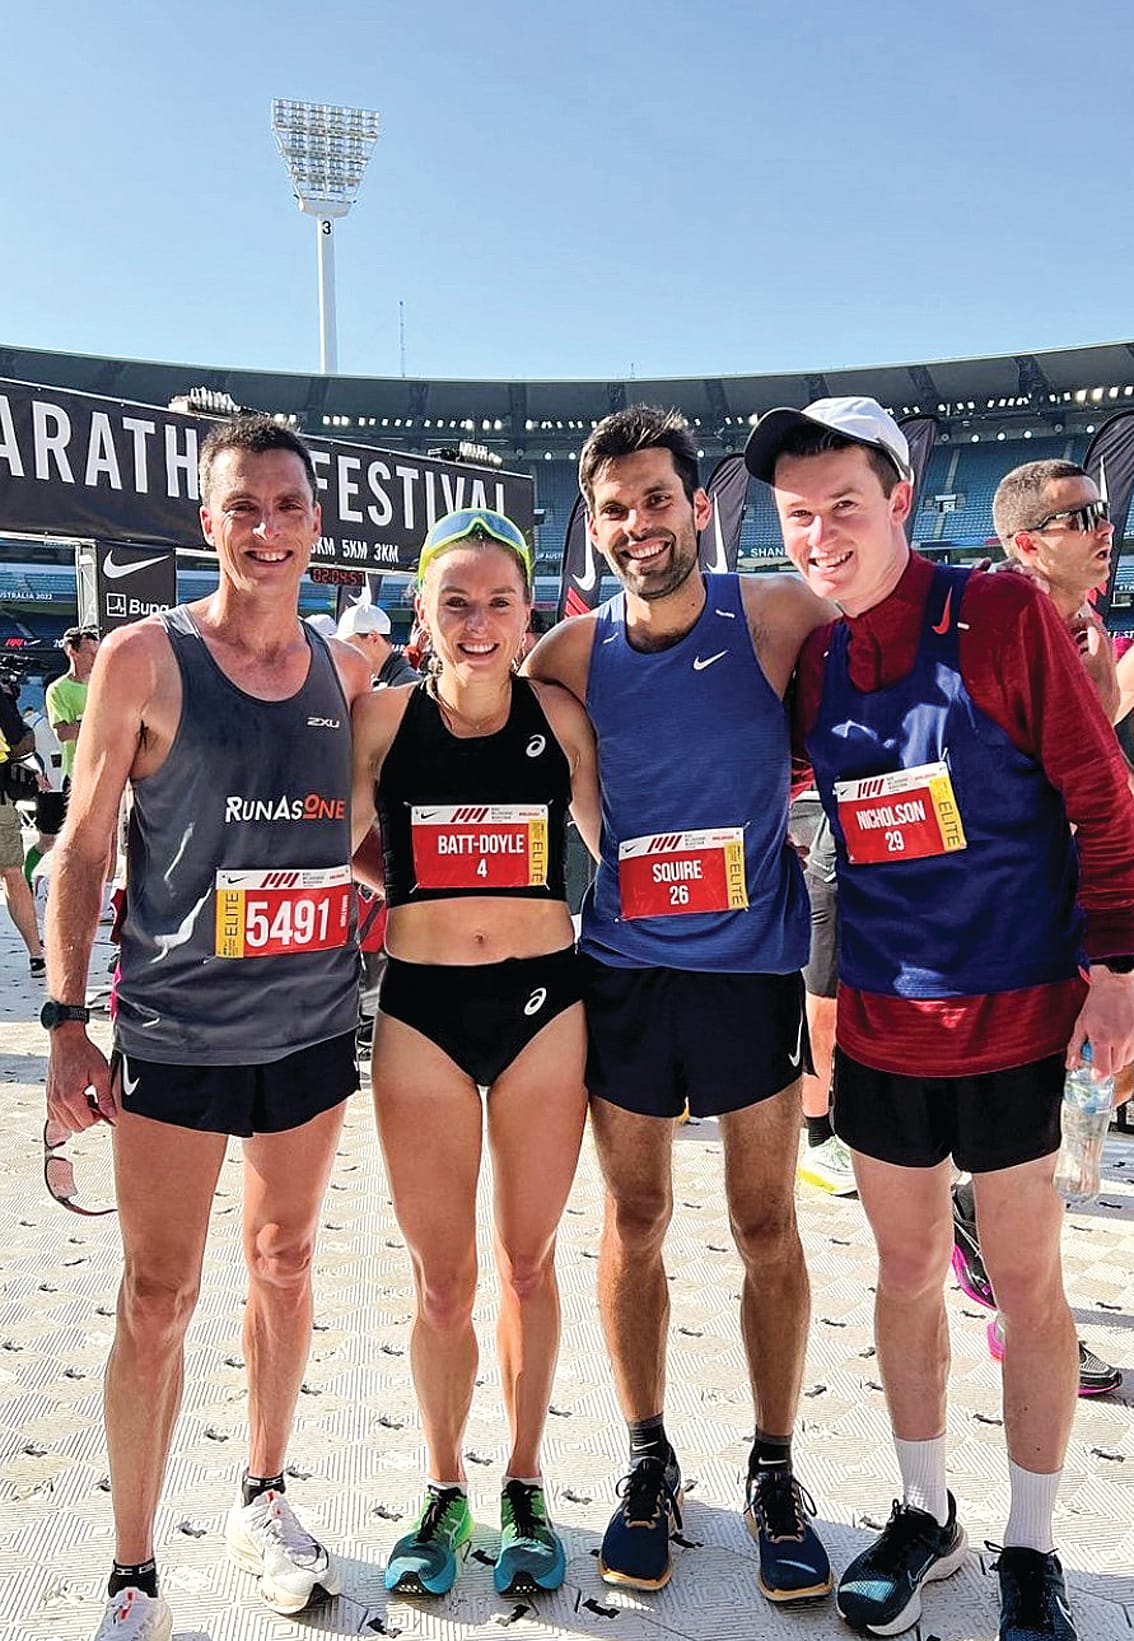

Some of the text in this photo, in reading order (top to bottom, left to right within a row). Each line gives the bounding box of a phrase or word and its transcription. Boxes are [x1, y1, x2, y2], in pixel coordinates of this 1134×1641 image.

[322, 220, 332, 235] 3
[342, 539, 368, 560] 5KM
[373, 543, 399, 562] 3KM
[307, 717, 340, 728] 2XU
[856, 799, 926, 831] NICHOLSON
[939, 800, 960, 848] ELITE
[437, 834, 525, 855] BATT-DOYLE
[885, 830, 905, 852] 29
[476, 858, 488, 878] 4
[533, 841, 544, 883] ELITE
[652, 859, 703, 884] SQUIRE
[669, 885, 689, 905] 26
[730, 863, 743, 905] ELITE
[225, 892, 239, 936] ELITE
[246, 897, 330, 948] 5491
